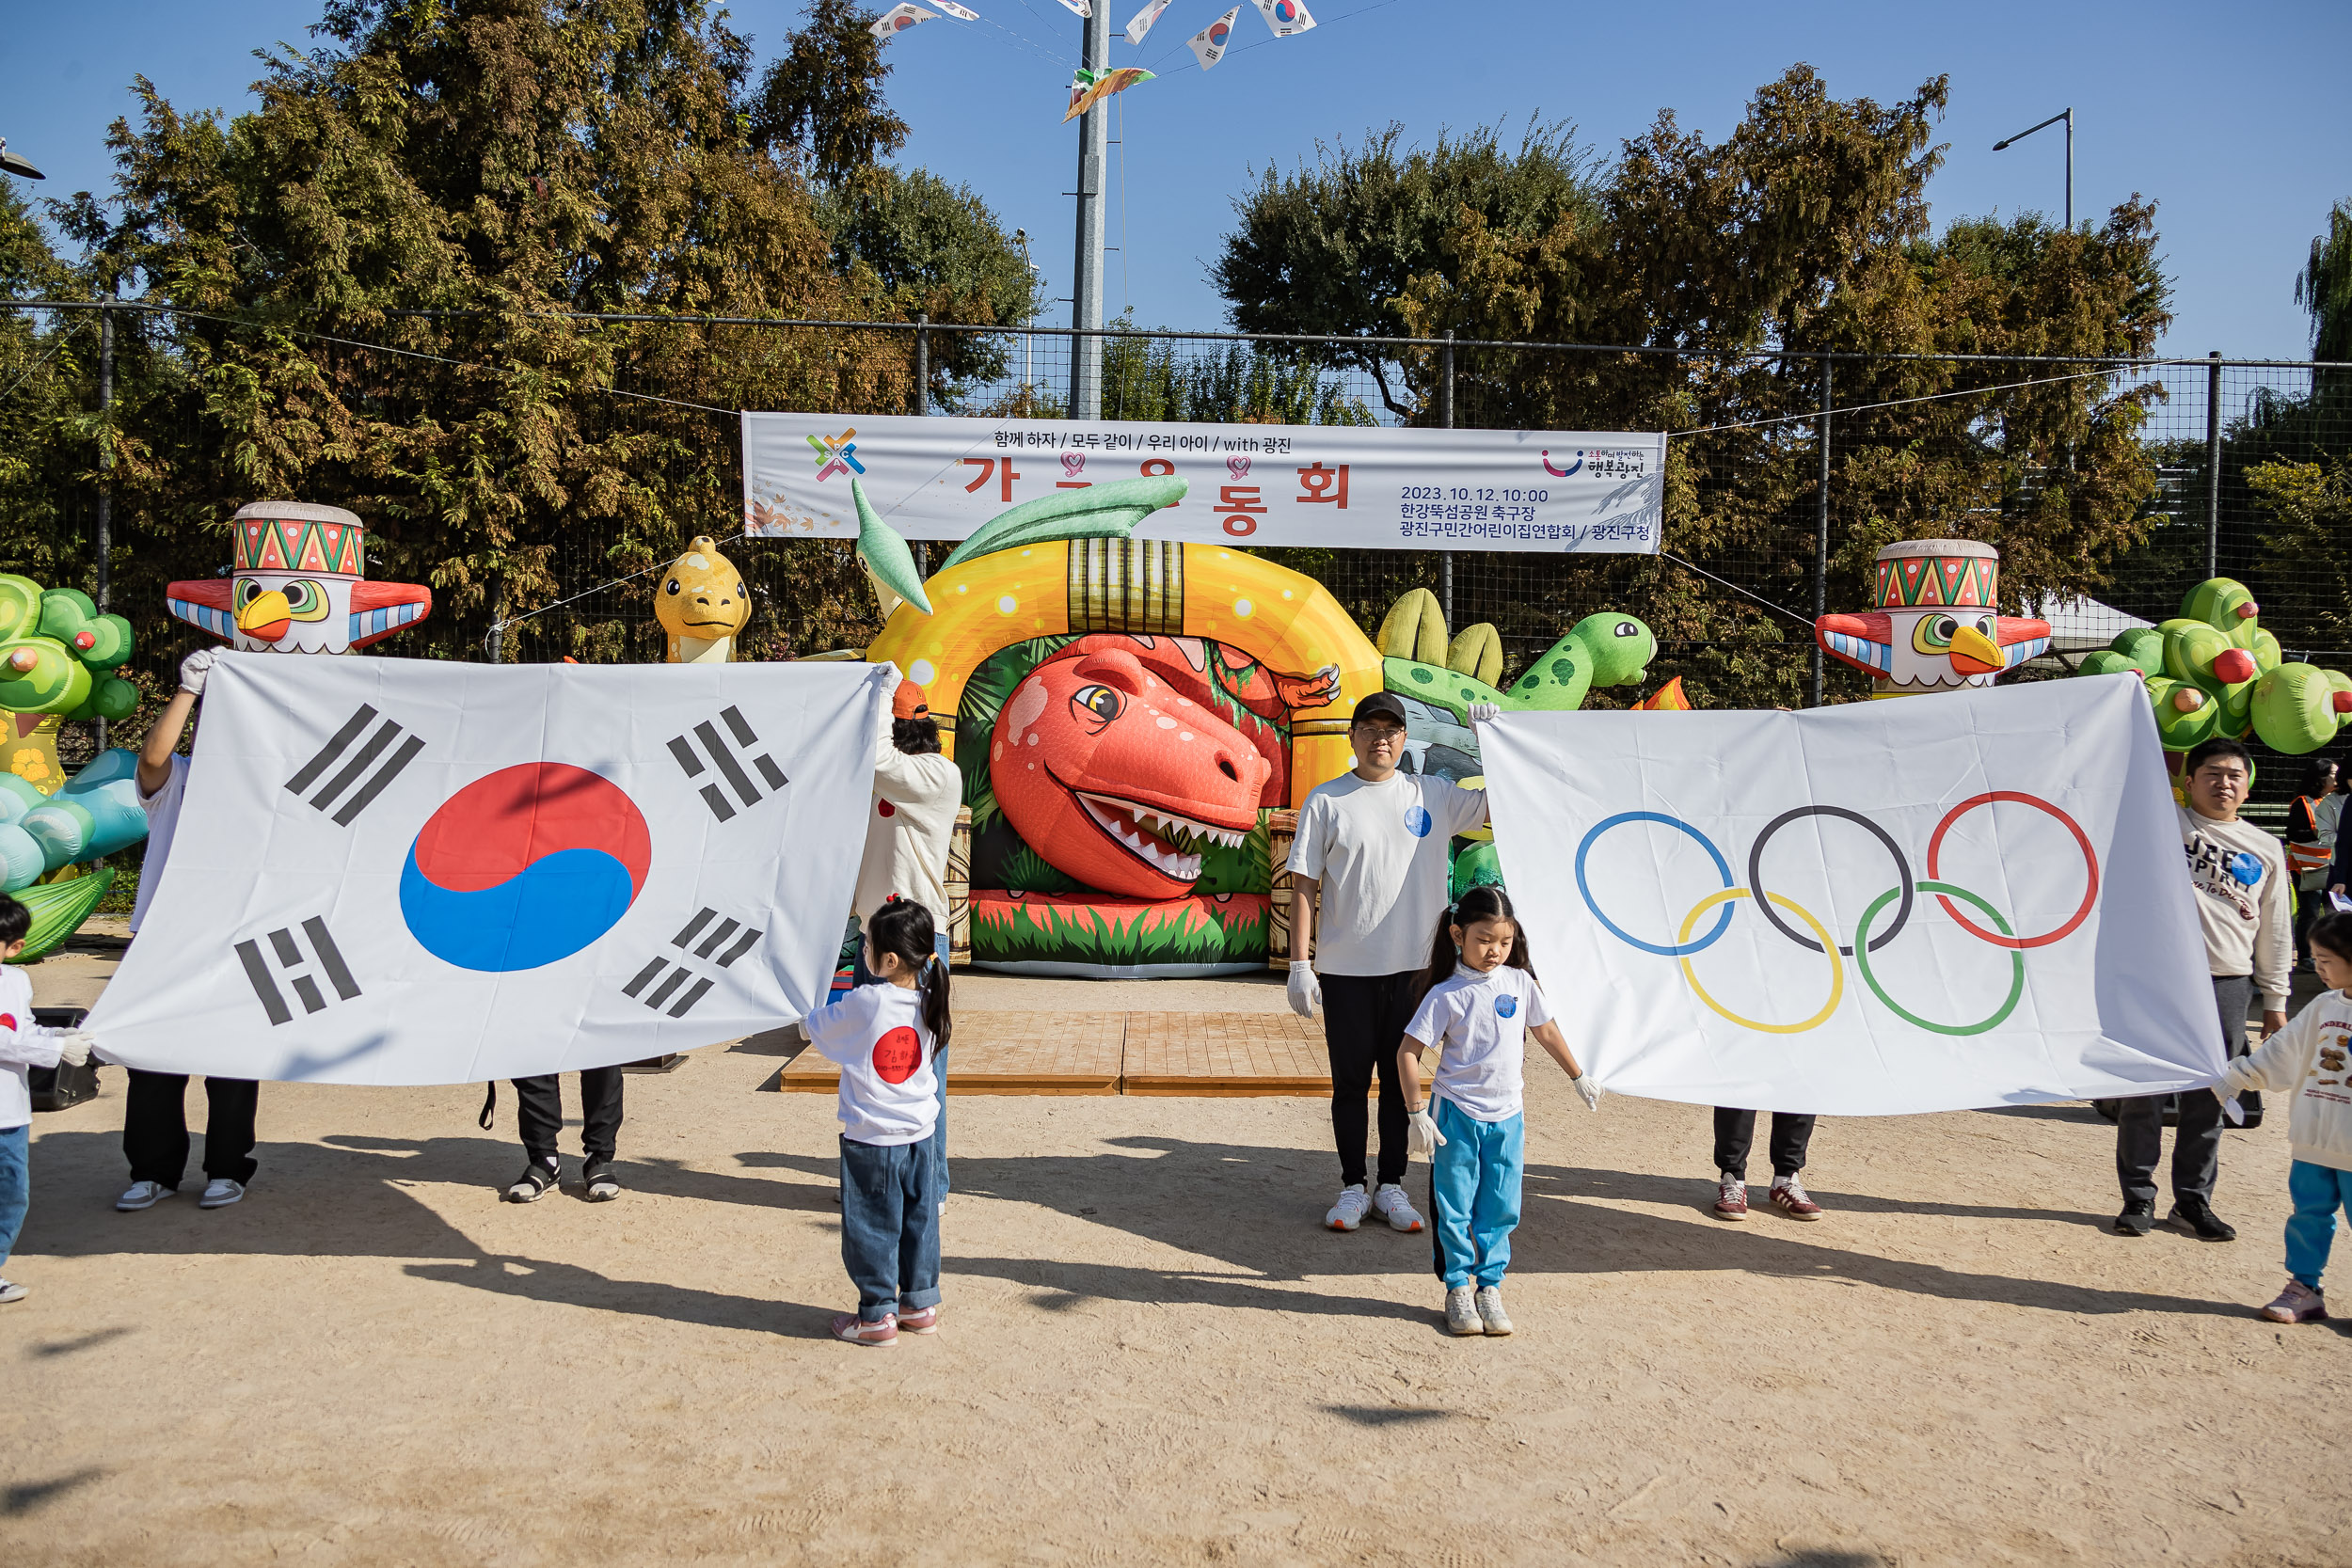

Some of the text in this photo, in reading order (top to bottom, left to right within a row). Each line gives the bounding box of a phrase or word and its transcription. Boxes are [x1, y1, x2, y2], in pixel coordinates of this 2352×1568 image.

[994, 432, 1292, 454] 함께 하자 / 모두 같이 / 우리 아이 / with 광진
[1588, 450, 1645, 461] 소통하며 발전하는
[1588, 460, 1645, 479] 행복광진
[1400, 502, 1536, 521] 한강뚝섬공원 축구장
[1399, 521, 1650, 541] 광진구민간어린이집연합회 / 광진구청
